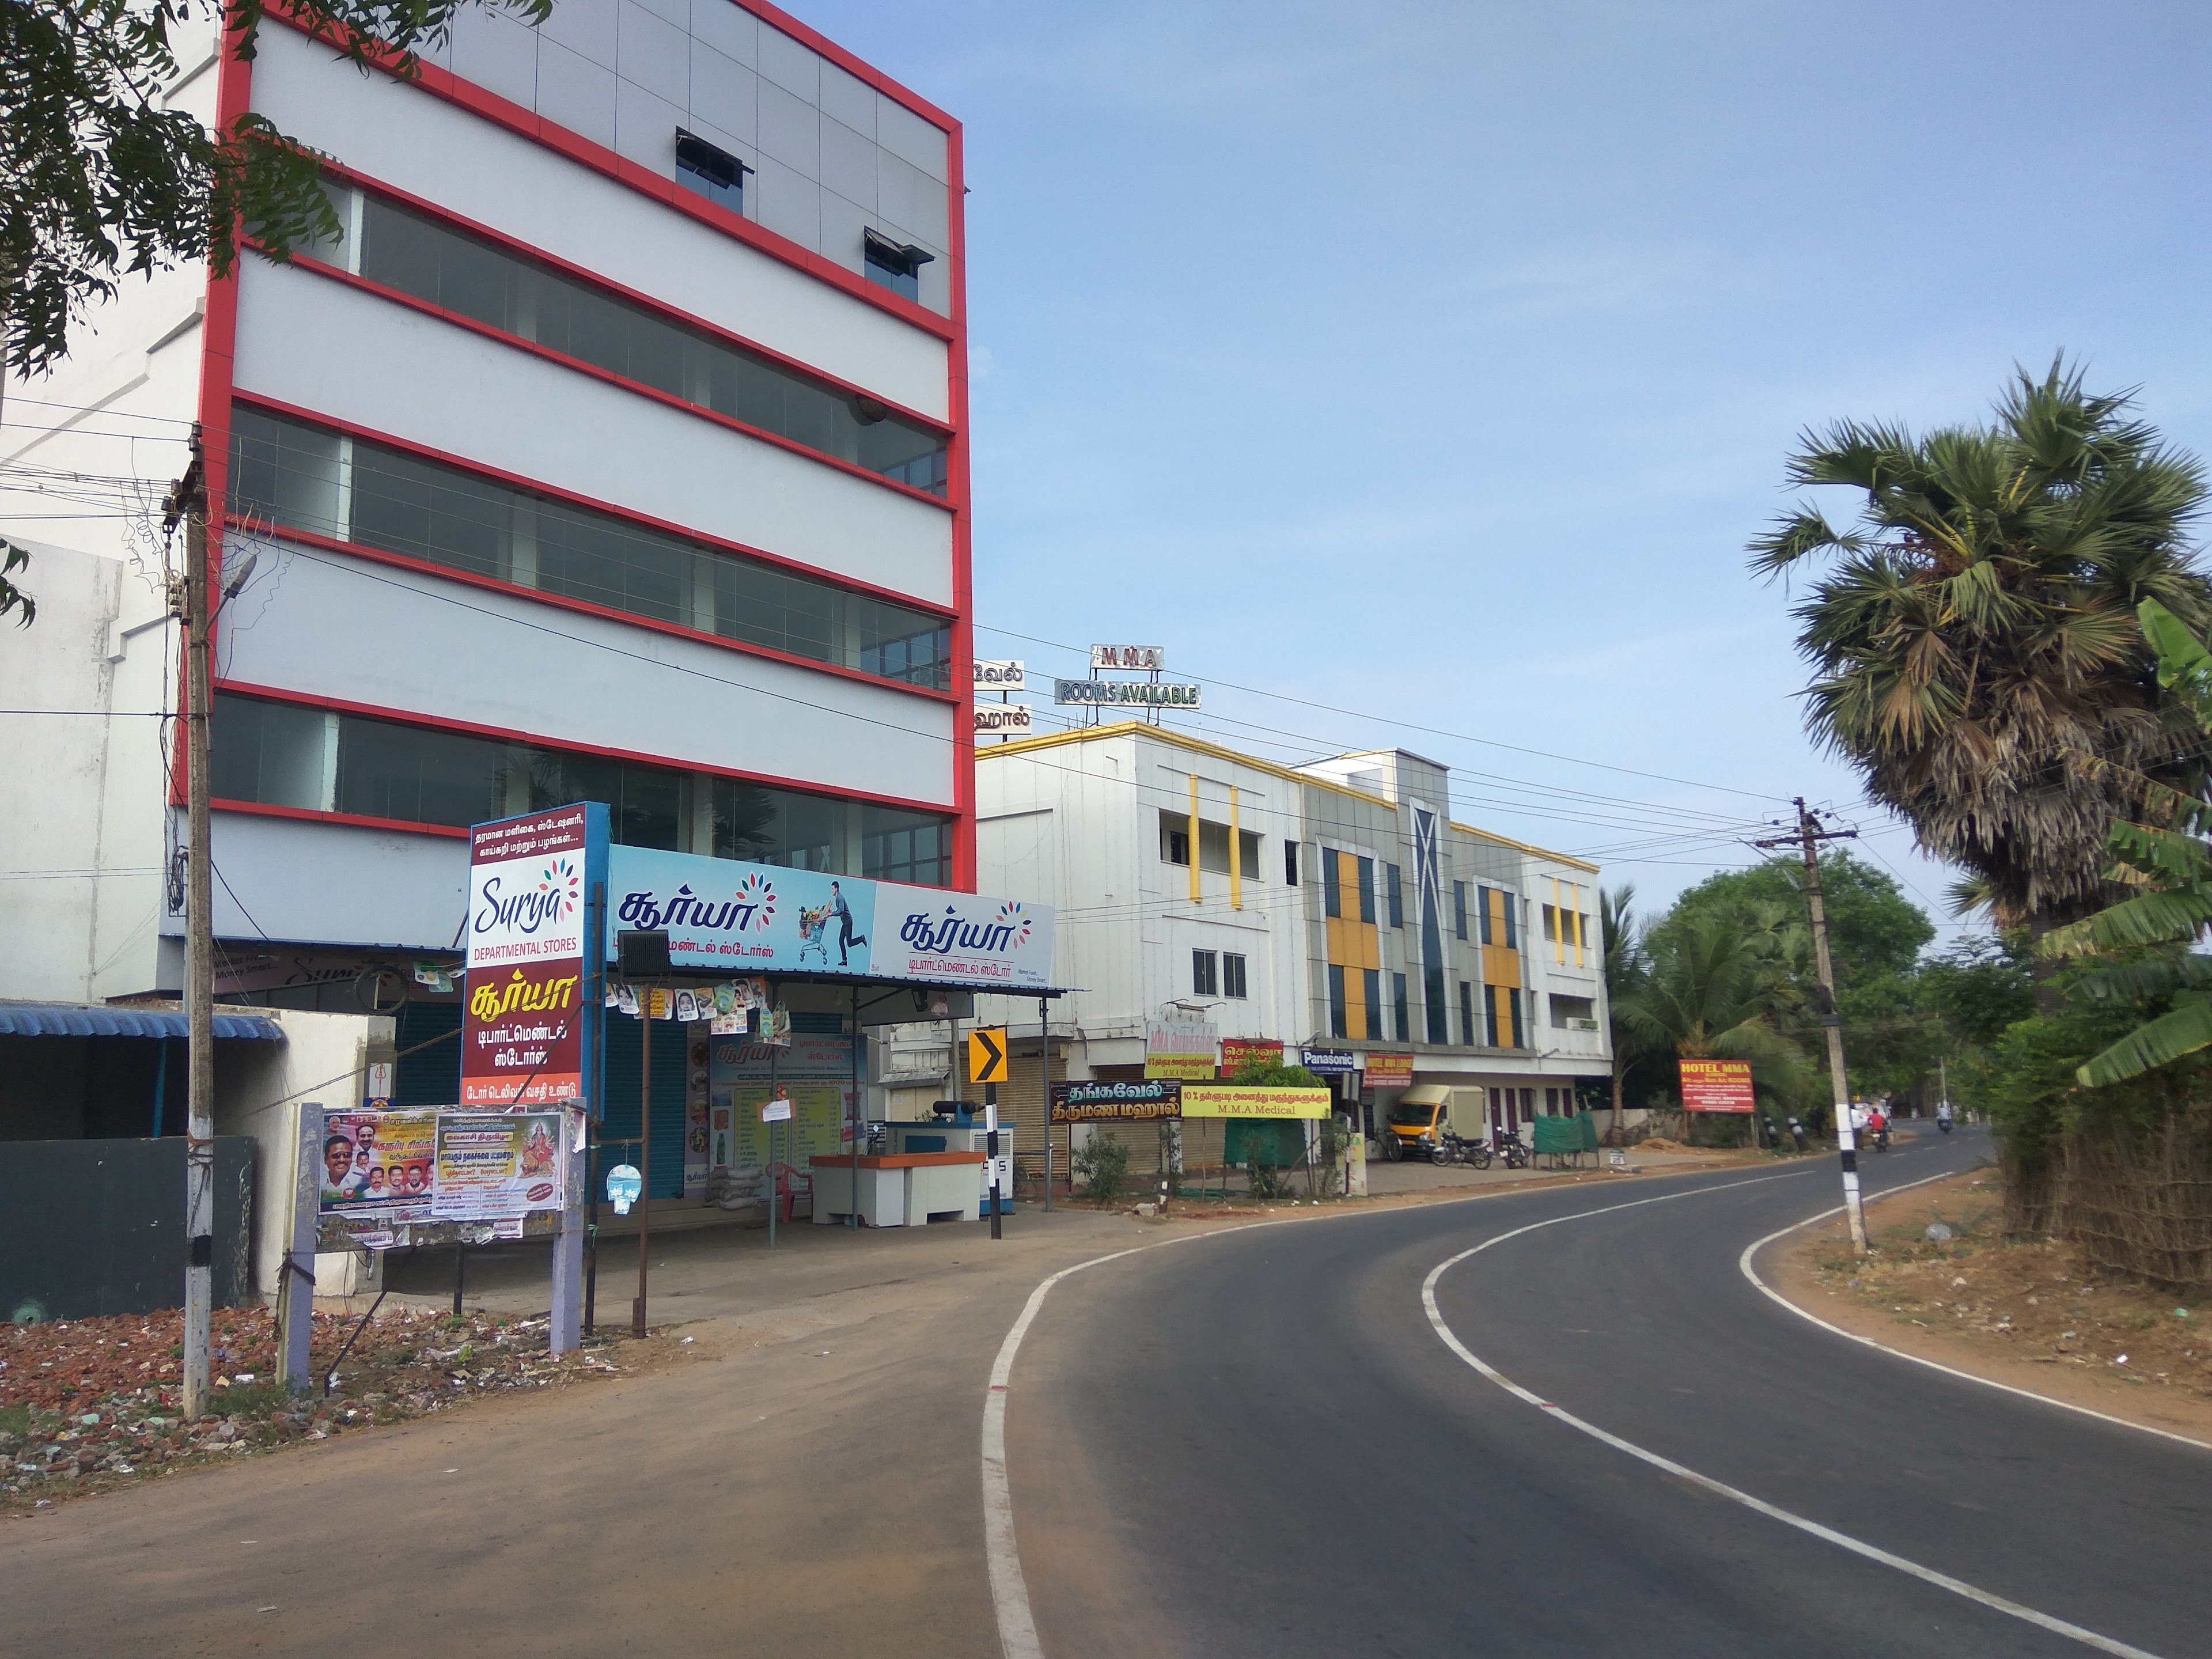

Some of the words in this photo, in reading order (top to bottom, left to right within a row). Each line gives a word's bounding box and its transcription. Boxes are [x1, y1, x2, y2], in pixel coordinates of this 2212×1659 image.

[974, 661, 1023, 681] வேல்
[1061, 683, 1116, 702] ROOMS
[1120, 684, 1197, 704] AVAILABLE
[974, 705, 1031, 731] ஹால்
[475, 830, 504, 845] தரமான
[479, 843, 509, 857] காய்கறி
[510, 838, 536, 855] மற்றும்
[475, 877, 561, 934] Surya
[618, 882, 759, 931] சூர்யா
[900, 903, 1016, 954] சூர்யா
[474, 941, 541, 961] DEPARTMENTAL
[543, 937, 577, 954] STORES
[719, 941, 774, 958] ஸ்டோர்ஸ்
[908, 956, 979, 975] டிபார்ட்மெண்டல்
[980, 961, 1011, 978] ஸ்டோர்
[470, 967, 578, 1022] சூர்யா
[478, 1019, 567, 1049] டிபார்ட்மெண்டல்
[495, 1046, 548, 1066] ஸ்டோர்ஸ்
[1304, 1051, 1353, 1065] Panasonic
[1681, 1063, 1719, 1073] HOTEL
[1722, 1064, 1749, 1073] MMA
[467, 1085, 487, 1100] டோர்
[527, 1082, 547, 1102] வசதி
[548, 1080, 577, 1099] உண்டு
[1067, 1080, 1162, 1104] தங்கவேல்
[1184, 1091, 1191, 1100] 10
[1193, 1091, 1198, 1100] %
[1199, 1091, 1232, 1103] தள்ளுபடி
[1233, 1092, 1268, 1104] அனைத்து
[1270, 1092, 1328, 1104] மருந்துகளுக்கும்
[1052, 1101, 1119, 1120] திருமண
[1120, 1096, 1180, 1120] மஹால்
[1217, 1105, 1252, 1114] M.M.A
[1255, 1105, 1296, 1115] Medical
[478, 1132, 510, 1141] திருவிழா
